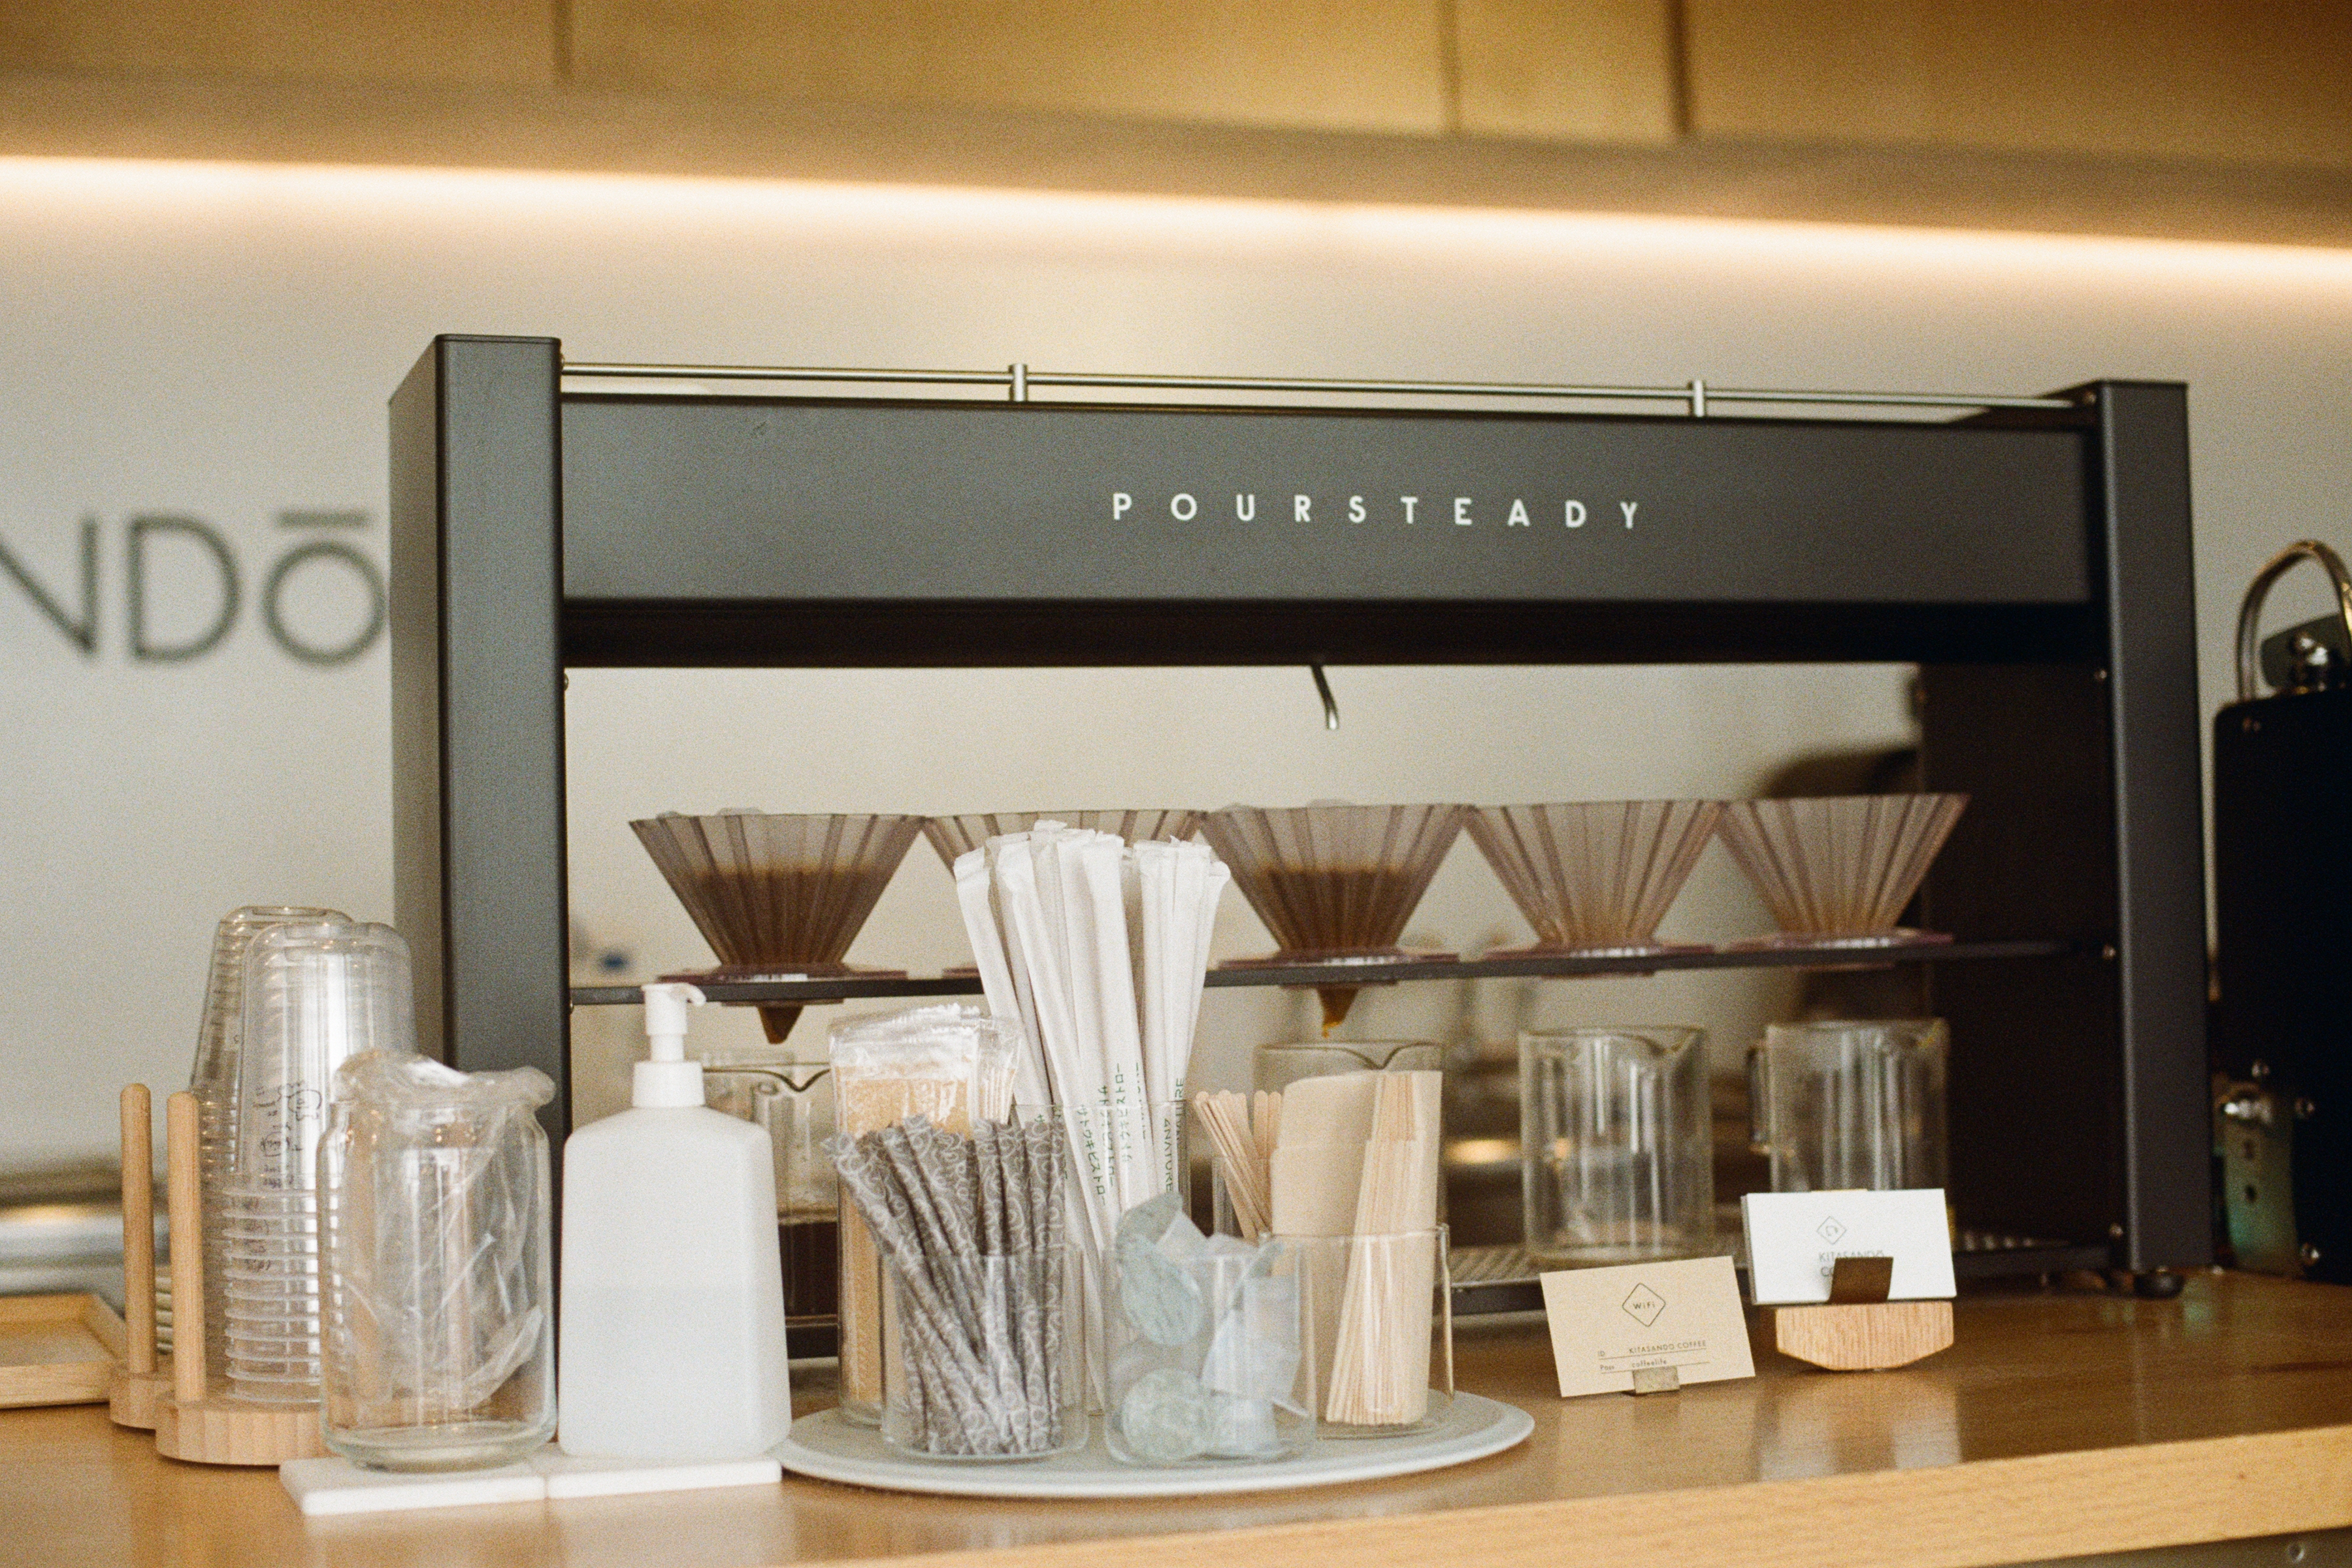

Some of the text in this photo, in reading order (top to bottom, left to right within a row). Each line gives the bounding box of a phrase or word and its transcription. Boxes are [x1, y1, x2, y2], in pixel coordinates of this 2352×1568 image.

[1113, 493, 1638, 529] POURSTEADY
[1077, 1104, 1105, 1205] サトウキビストロー
[1678, 1340, 1707, 1348] COFFEE
